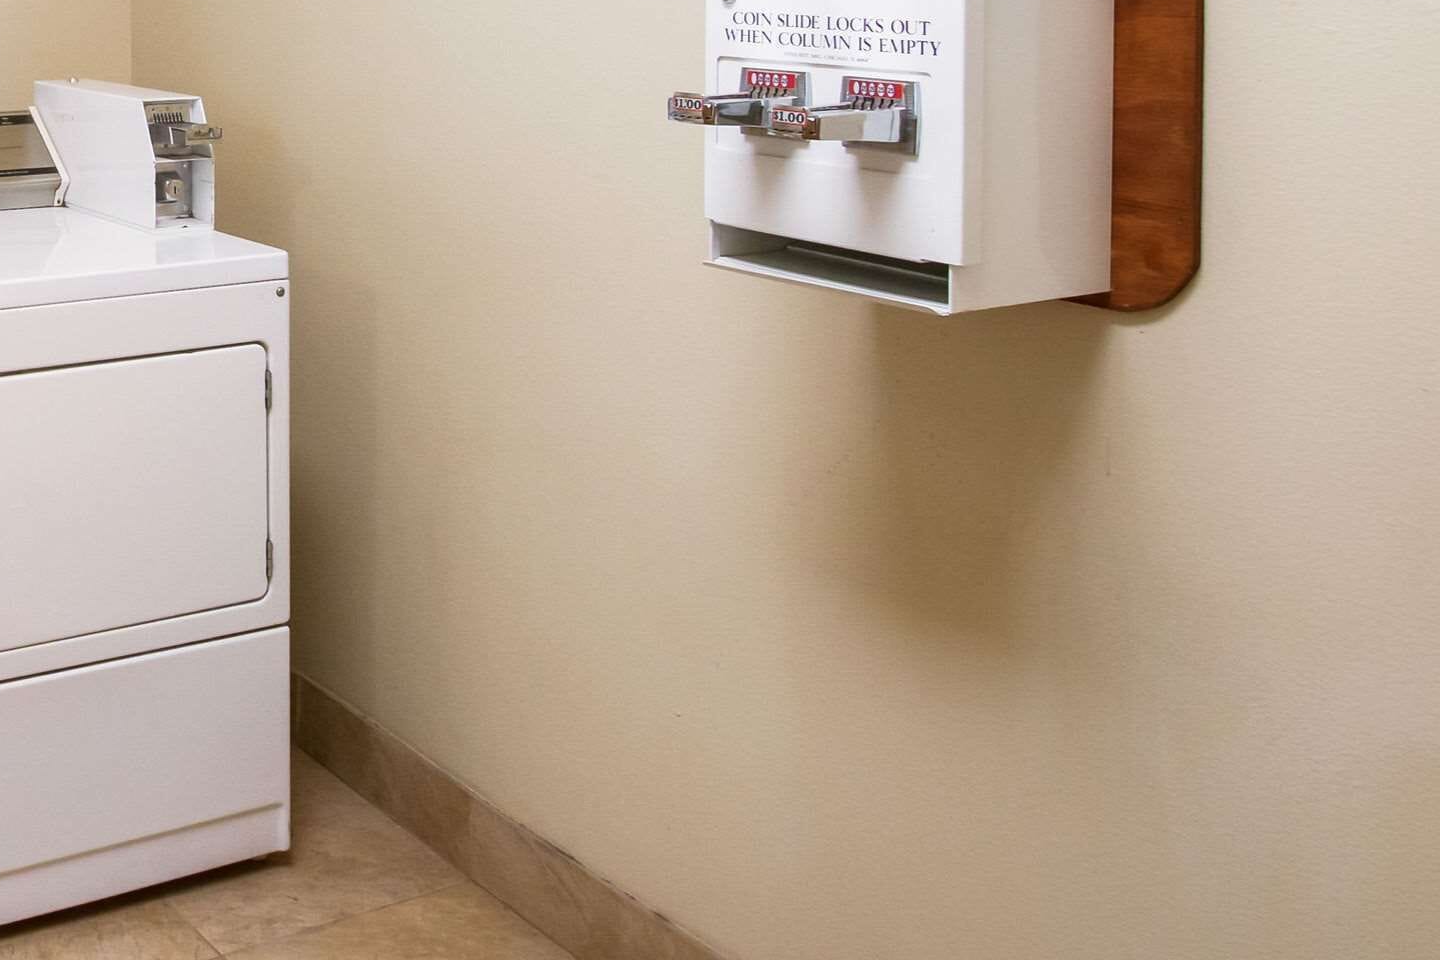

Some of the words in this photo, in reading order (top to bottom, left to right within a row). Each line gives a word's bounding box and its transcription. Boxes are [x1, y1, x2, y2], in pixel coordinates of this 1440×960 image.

[732, 11, 772, 26] COIN
[777, 13, 820, 30] SLIDE
[826, 16, 884, 33] LOCKS
[891, 19, 931, 36] OUT
[724, 27, 773, 44] WHEN
[778, 31, 851, 50] COLUMN
[858, 36, 872, 52] IS
[879, 38, 941, 57] EMPTY
[774, 110, 805, 124] $1.00
